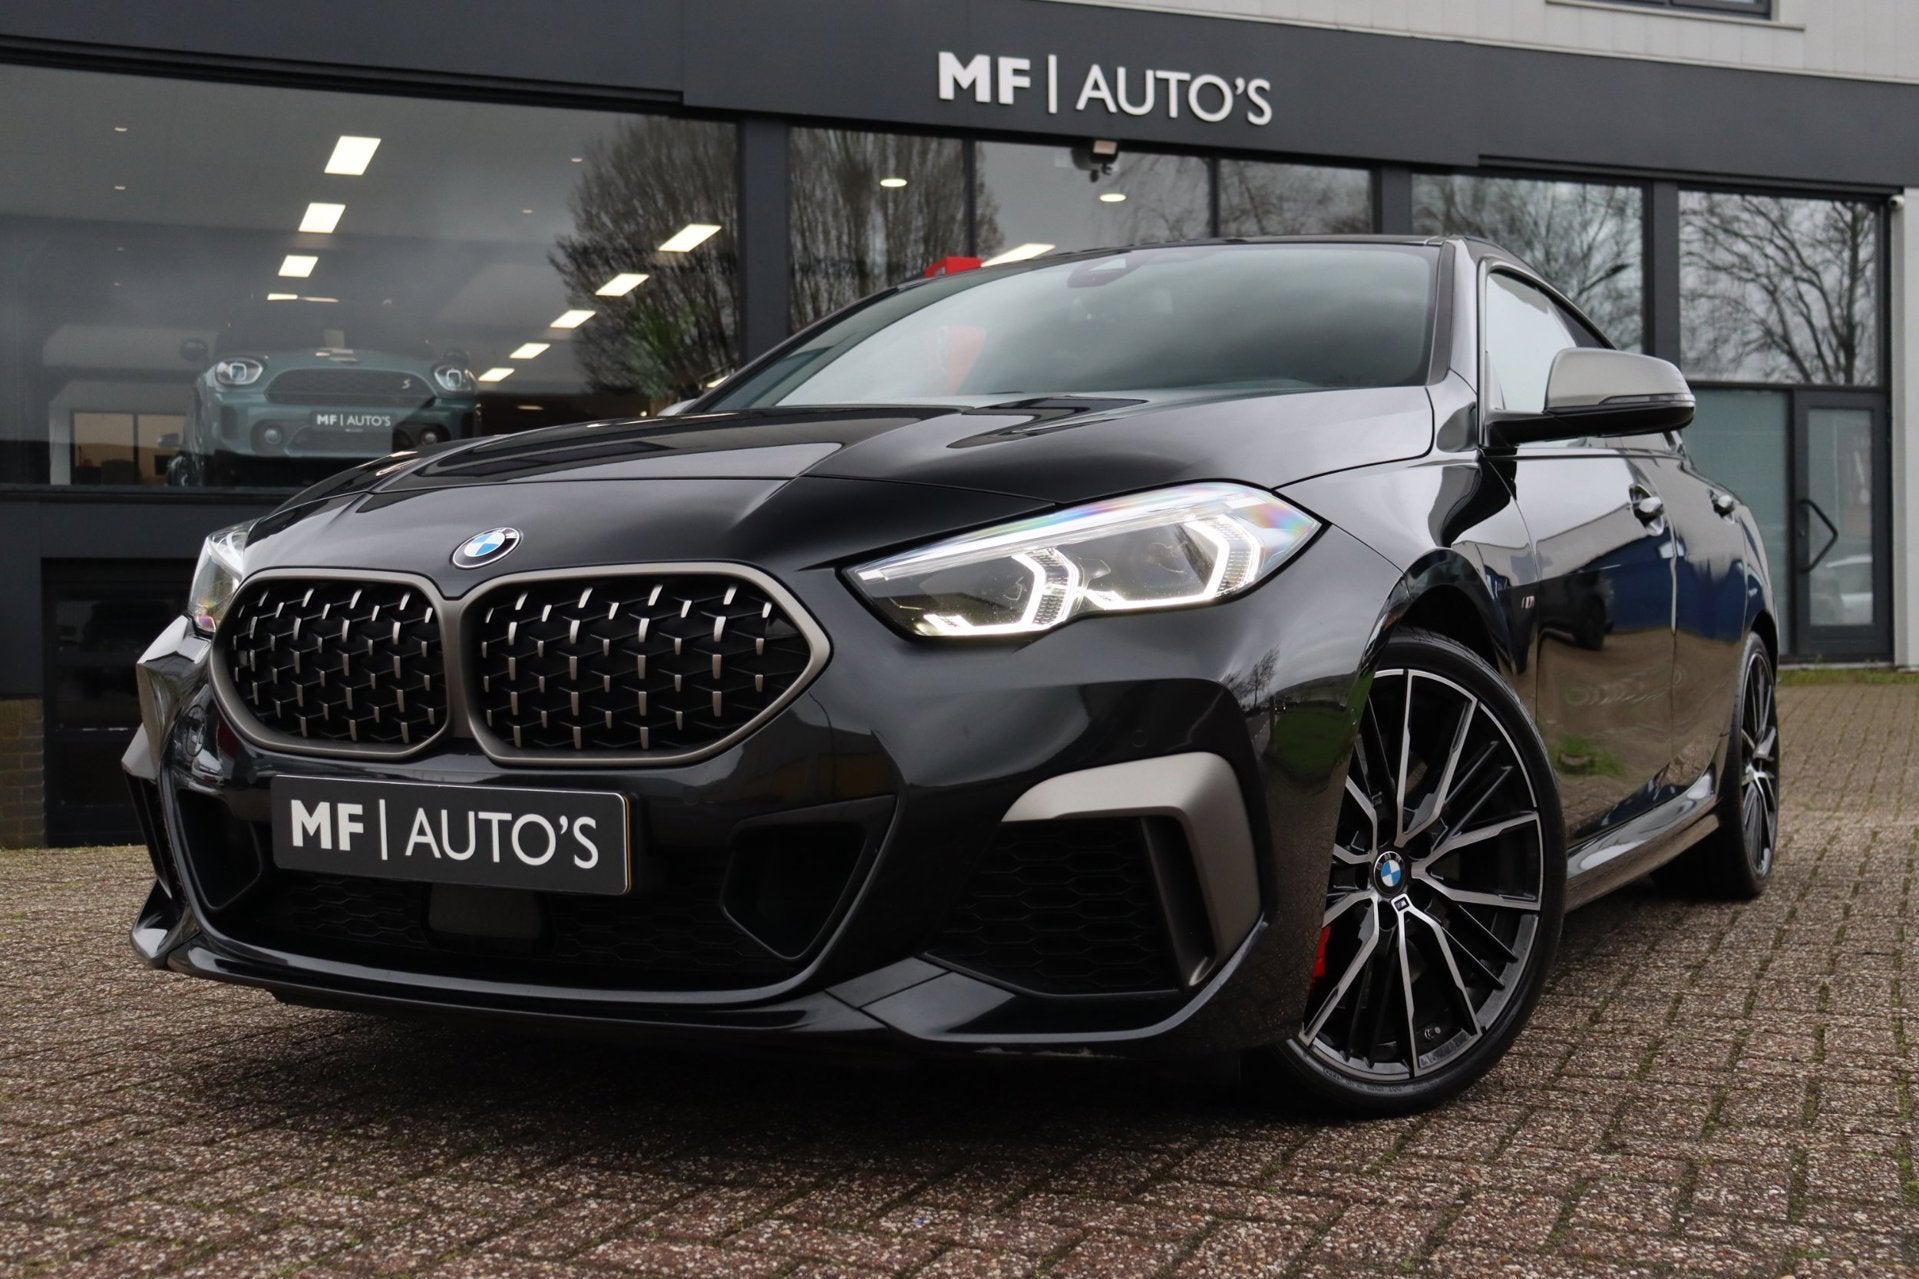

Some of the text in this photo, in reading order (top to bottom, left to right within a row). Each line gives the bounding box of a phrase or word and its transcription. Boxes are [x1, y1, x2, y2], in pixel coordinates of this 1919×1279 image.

[939, 52, 1271, 124] MF AUTO'S
[317, 414, 391, 426] MF AUTO'S
[291, 800, 598, 868] MF AUTO'S
